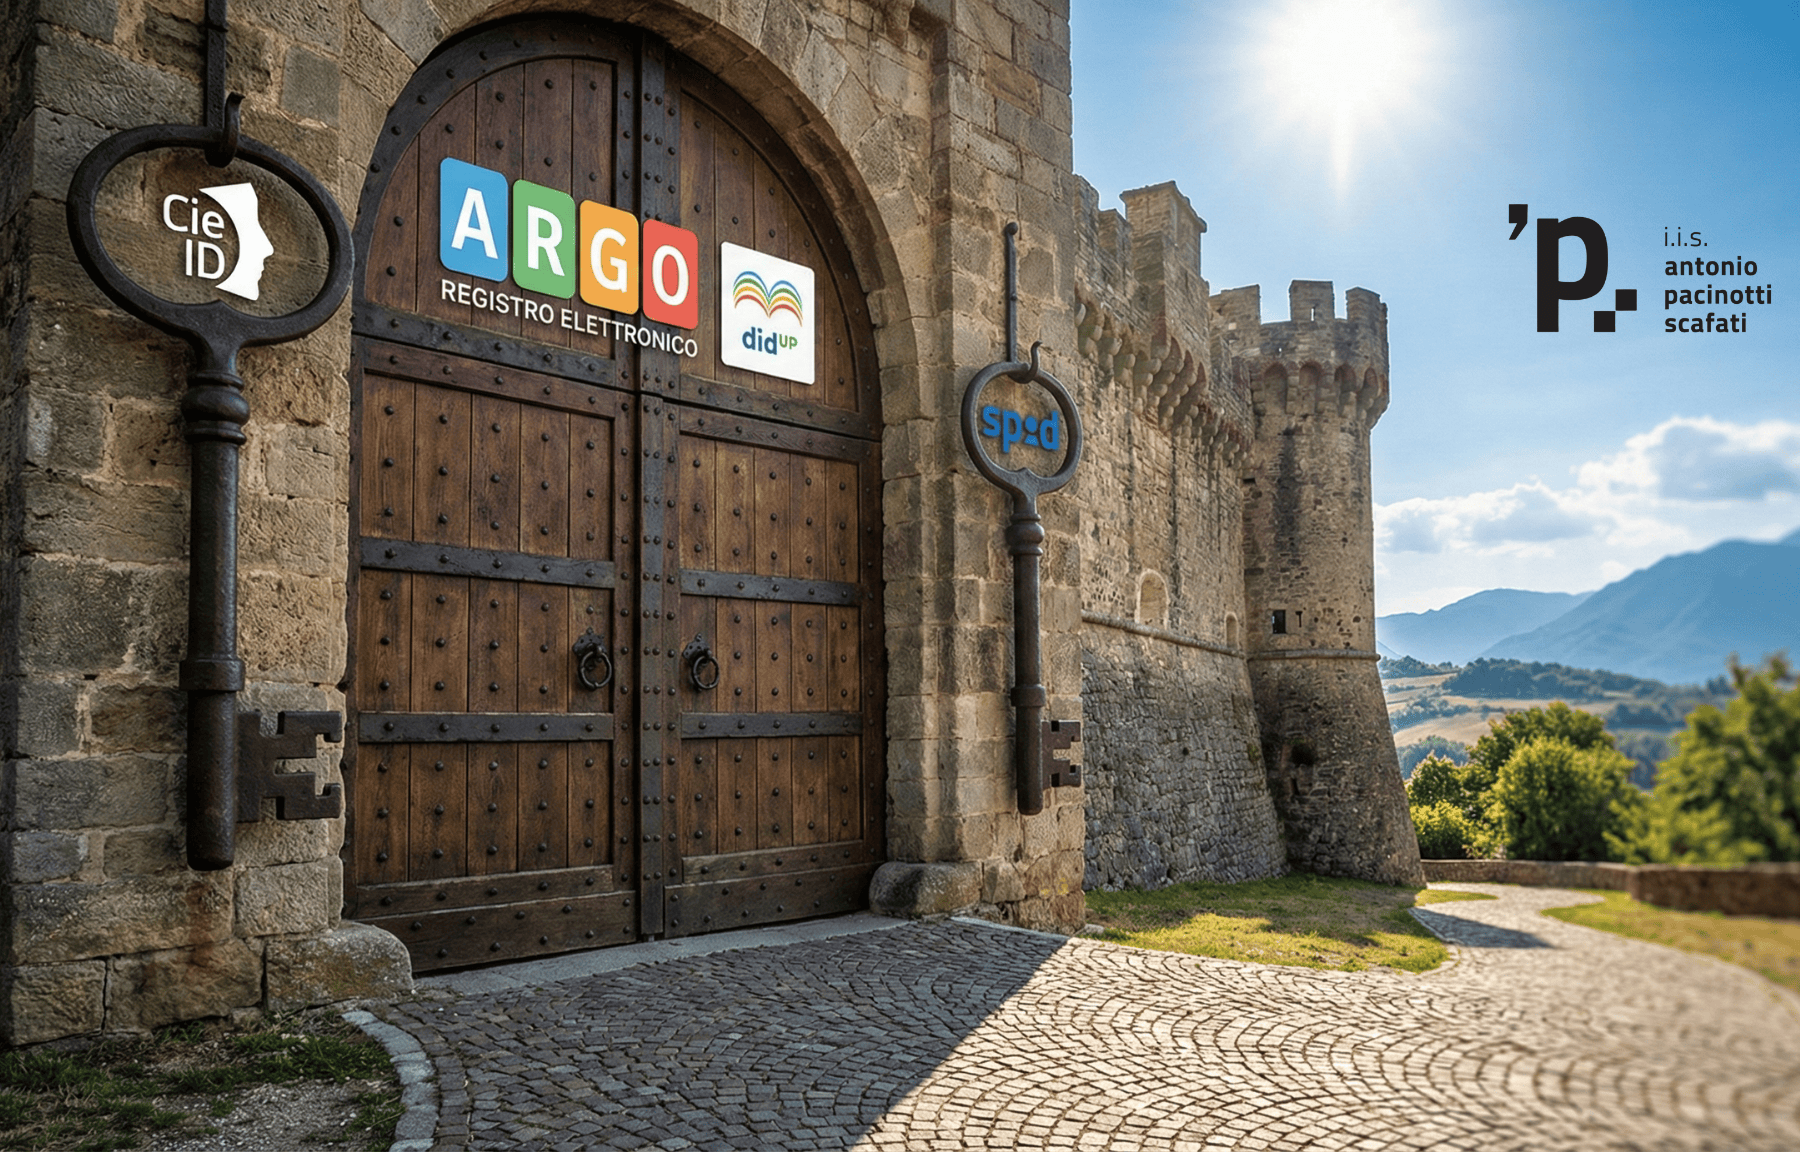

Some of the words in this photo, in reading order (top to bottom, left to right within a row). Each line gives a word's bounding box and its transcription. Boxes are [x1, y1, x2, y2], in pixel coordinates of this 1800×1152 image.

[162, 193, 226, 239] Cie
[450, 187, 690, 306] ARGO
[185, 239, 226, 280] ID
[440, 278, 555, 325] REGISTRO
[560, 308, 699, 359] ELETTRONICO
